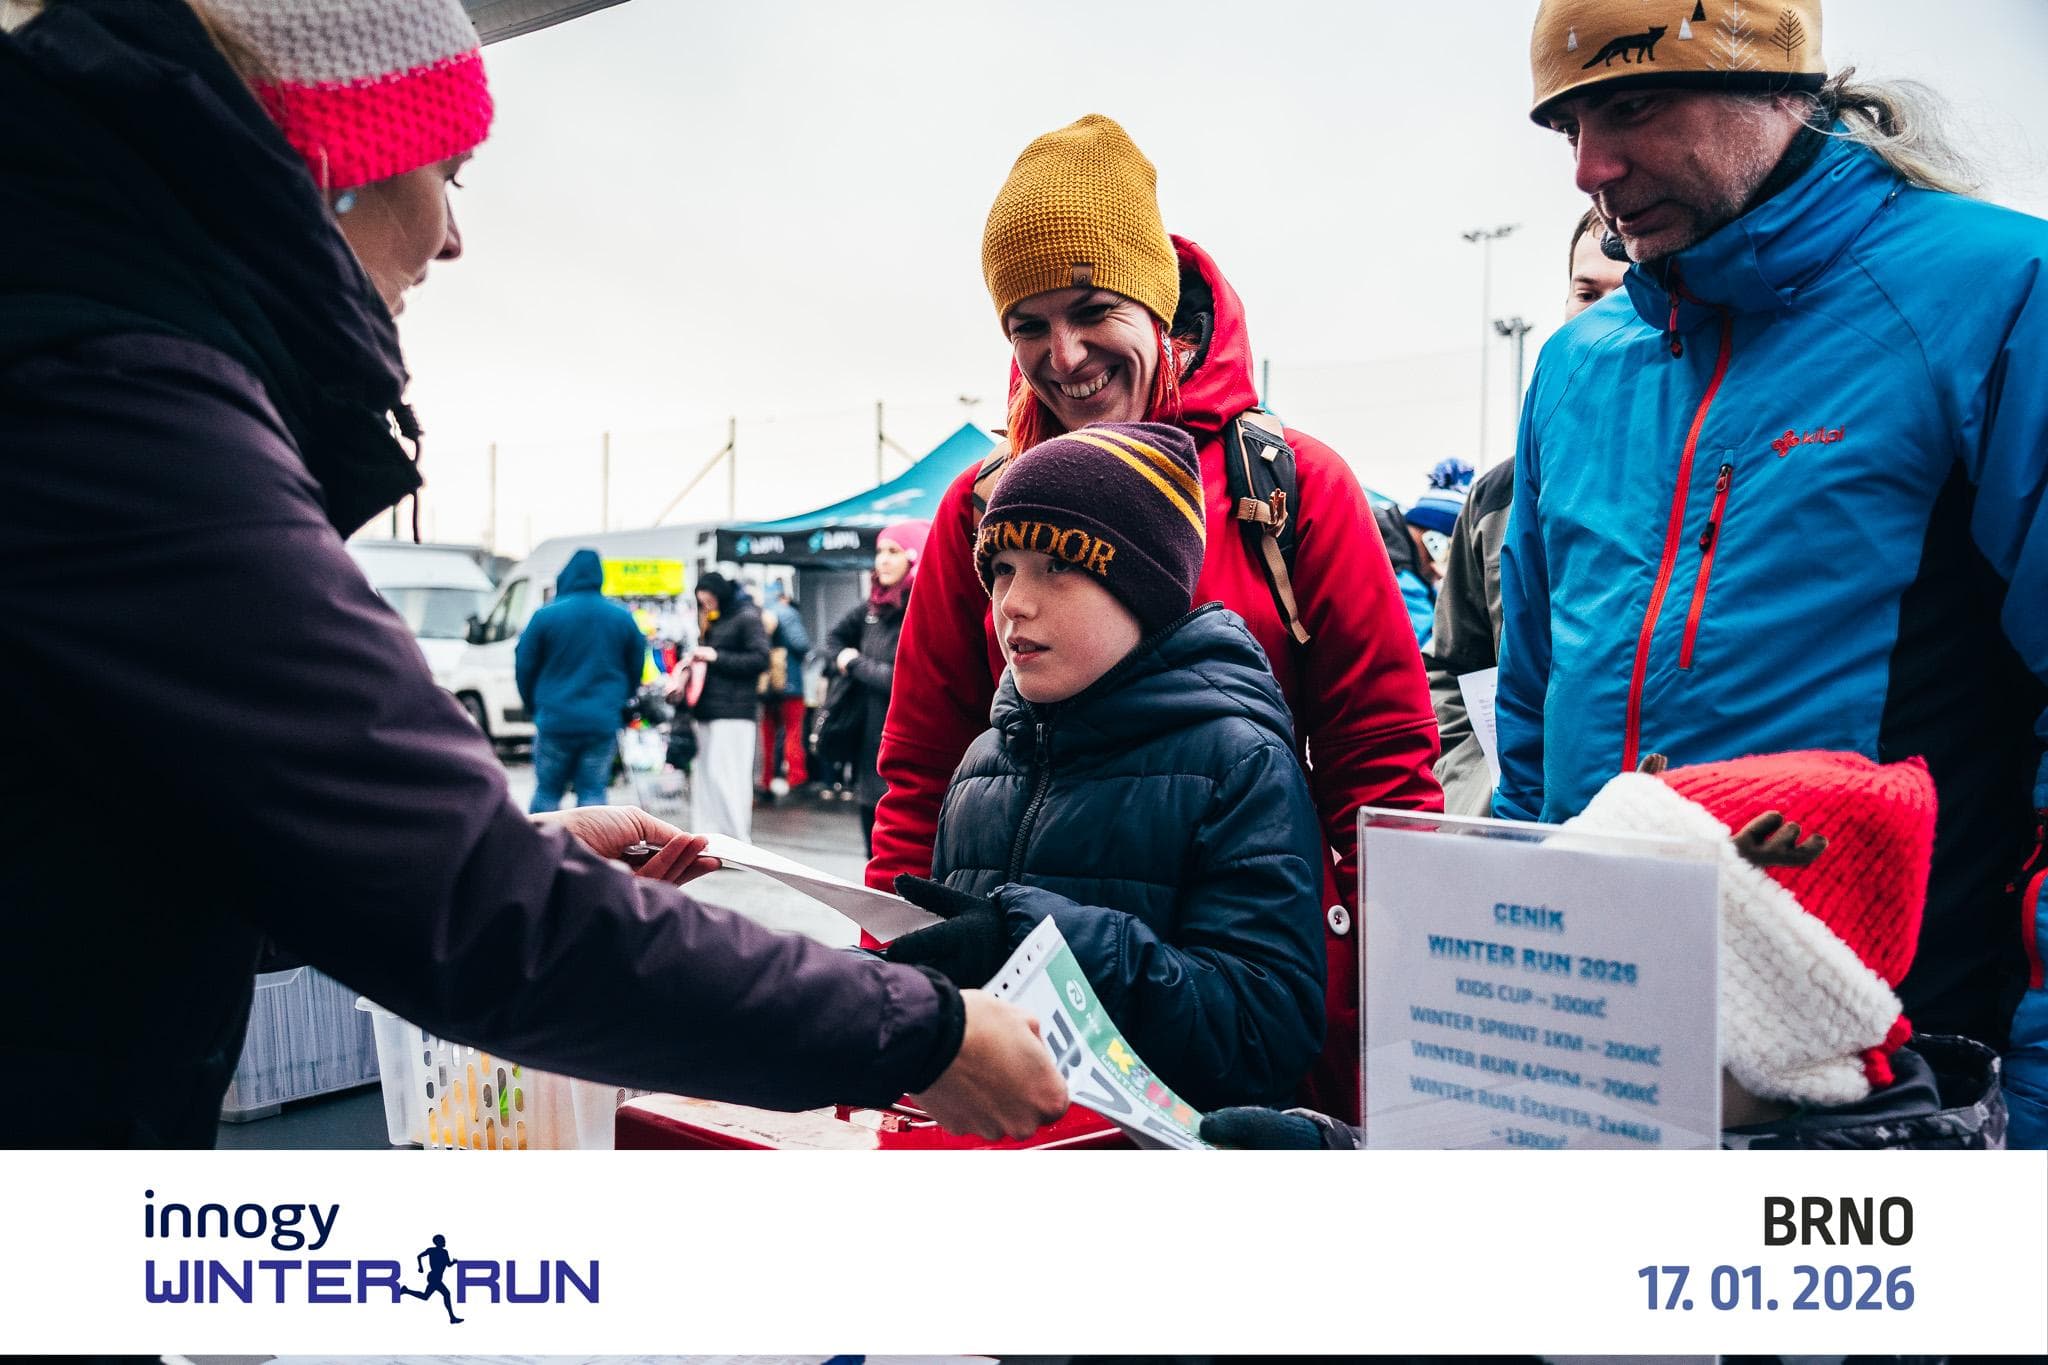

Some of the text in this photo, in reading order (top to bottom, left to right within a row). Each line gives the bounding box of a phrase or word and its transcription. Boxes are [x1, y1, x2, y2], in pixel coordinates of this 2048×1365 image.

[1493, 902, 1565, 933] CENÍK
[1428, 934, 1638, 985] WINTER RUN 2026
[1456, 977, 1493, 999] KIDS
[1498, 981, 1533, 1004] CUP
[1410, 1005, 1474, 1031] WINTER
[1477, 1014, 1537, 1043] SPRINT
[1411, 1039, 1475, 1069] WINTER
[1479, 1050, 1517, 1077] RUN
[1410, 1074, 1474, 1102] WINTER
[1478, 1087, 1516, 1113] RUN
